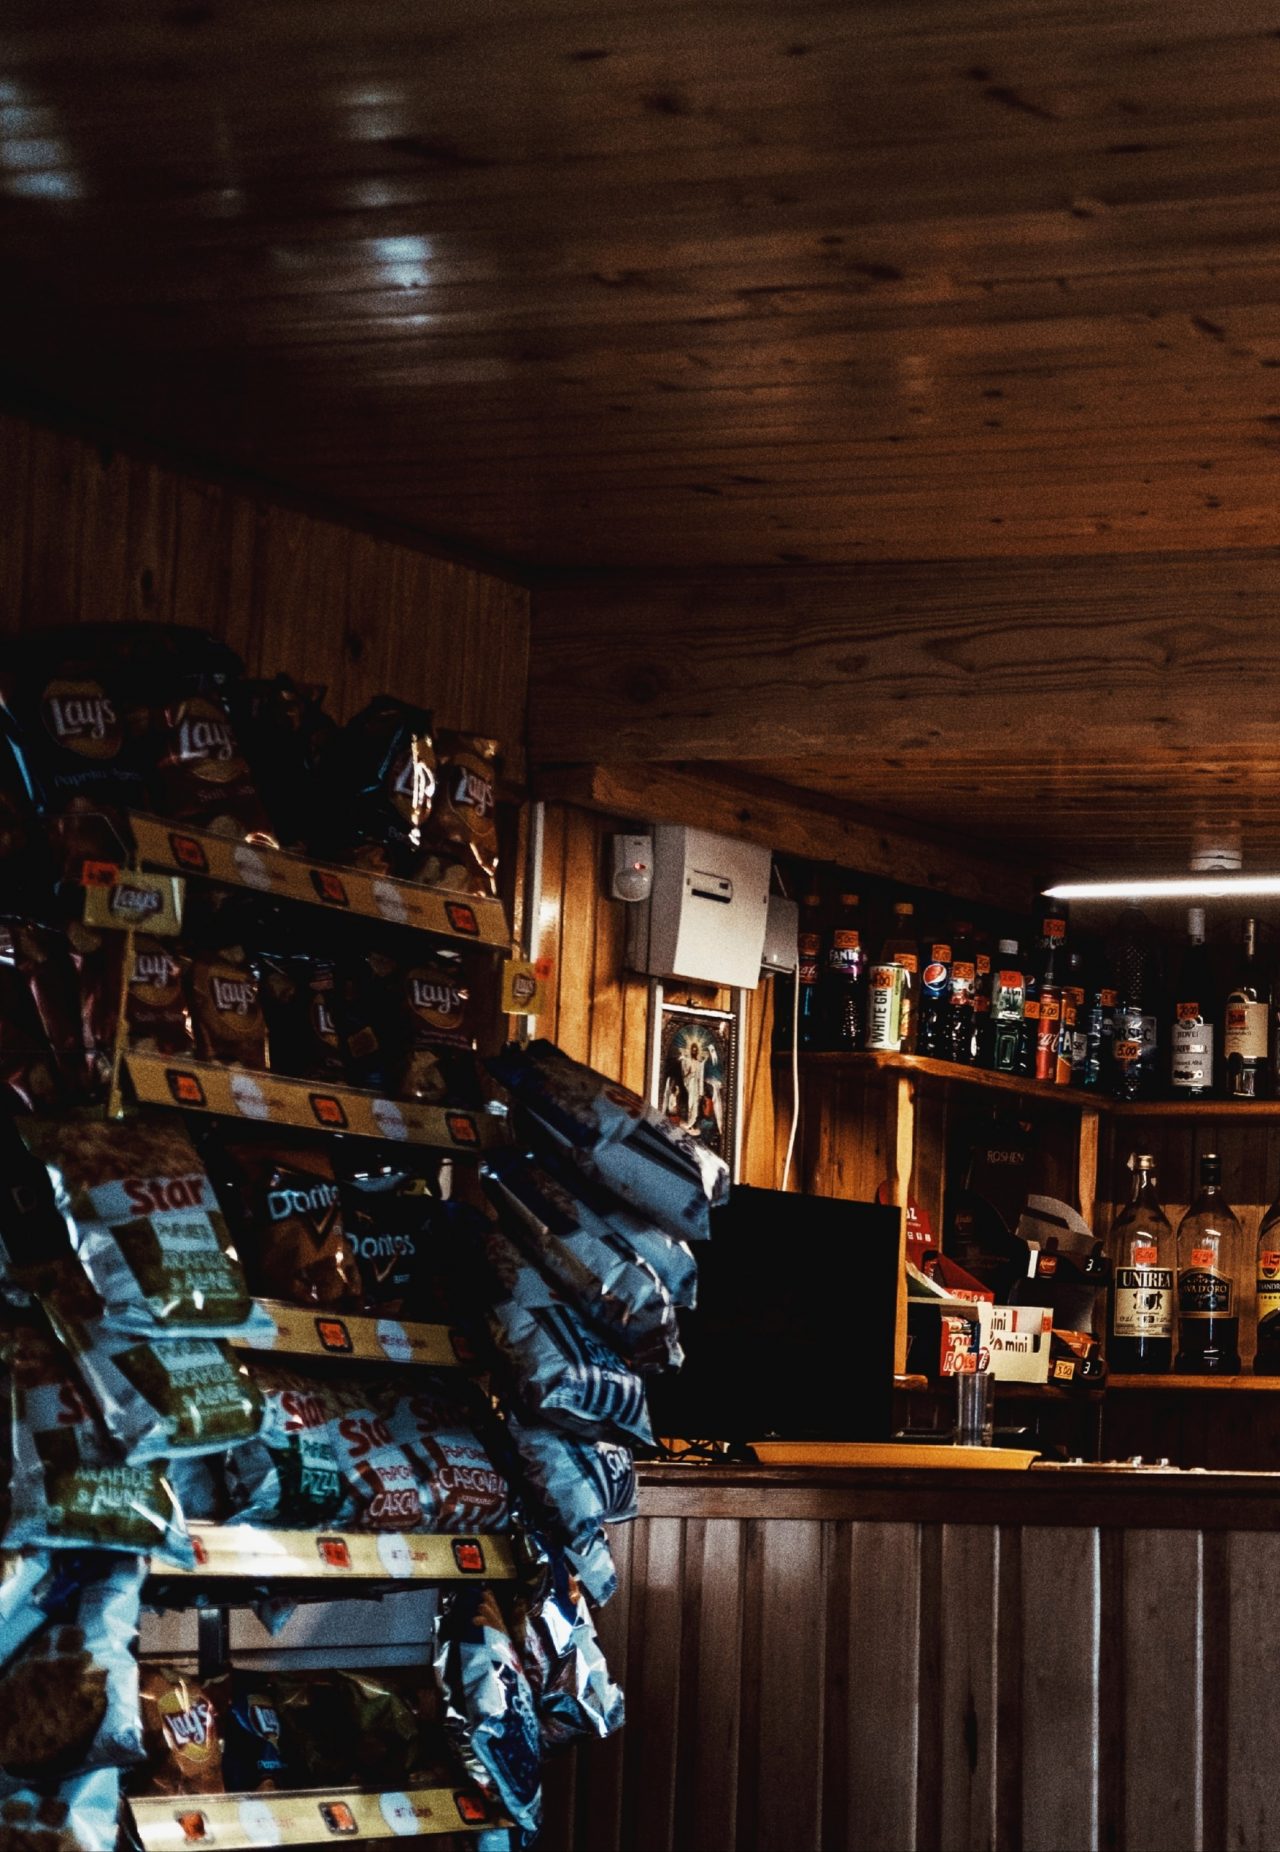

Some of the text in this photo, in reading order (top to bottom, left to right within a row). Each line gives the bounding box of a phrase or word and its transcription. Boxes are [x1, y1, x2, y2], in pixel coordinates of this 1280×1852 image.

[871, 1008, 888, 1044] WHITE
[123, 1178, 204, 1215] Star
[1122, 1271, 1171, 1288] UNIREA
[1004, 1334, 1027, 1353] mini
[1055, 1364, 1072, 1376] 3.00
